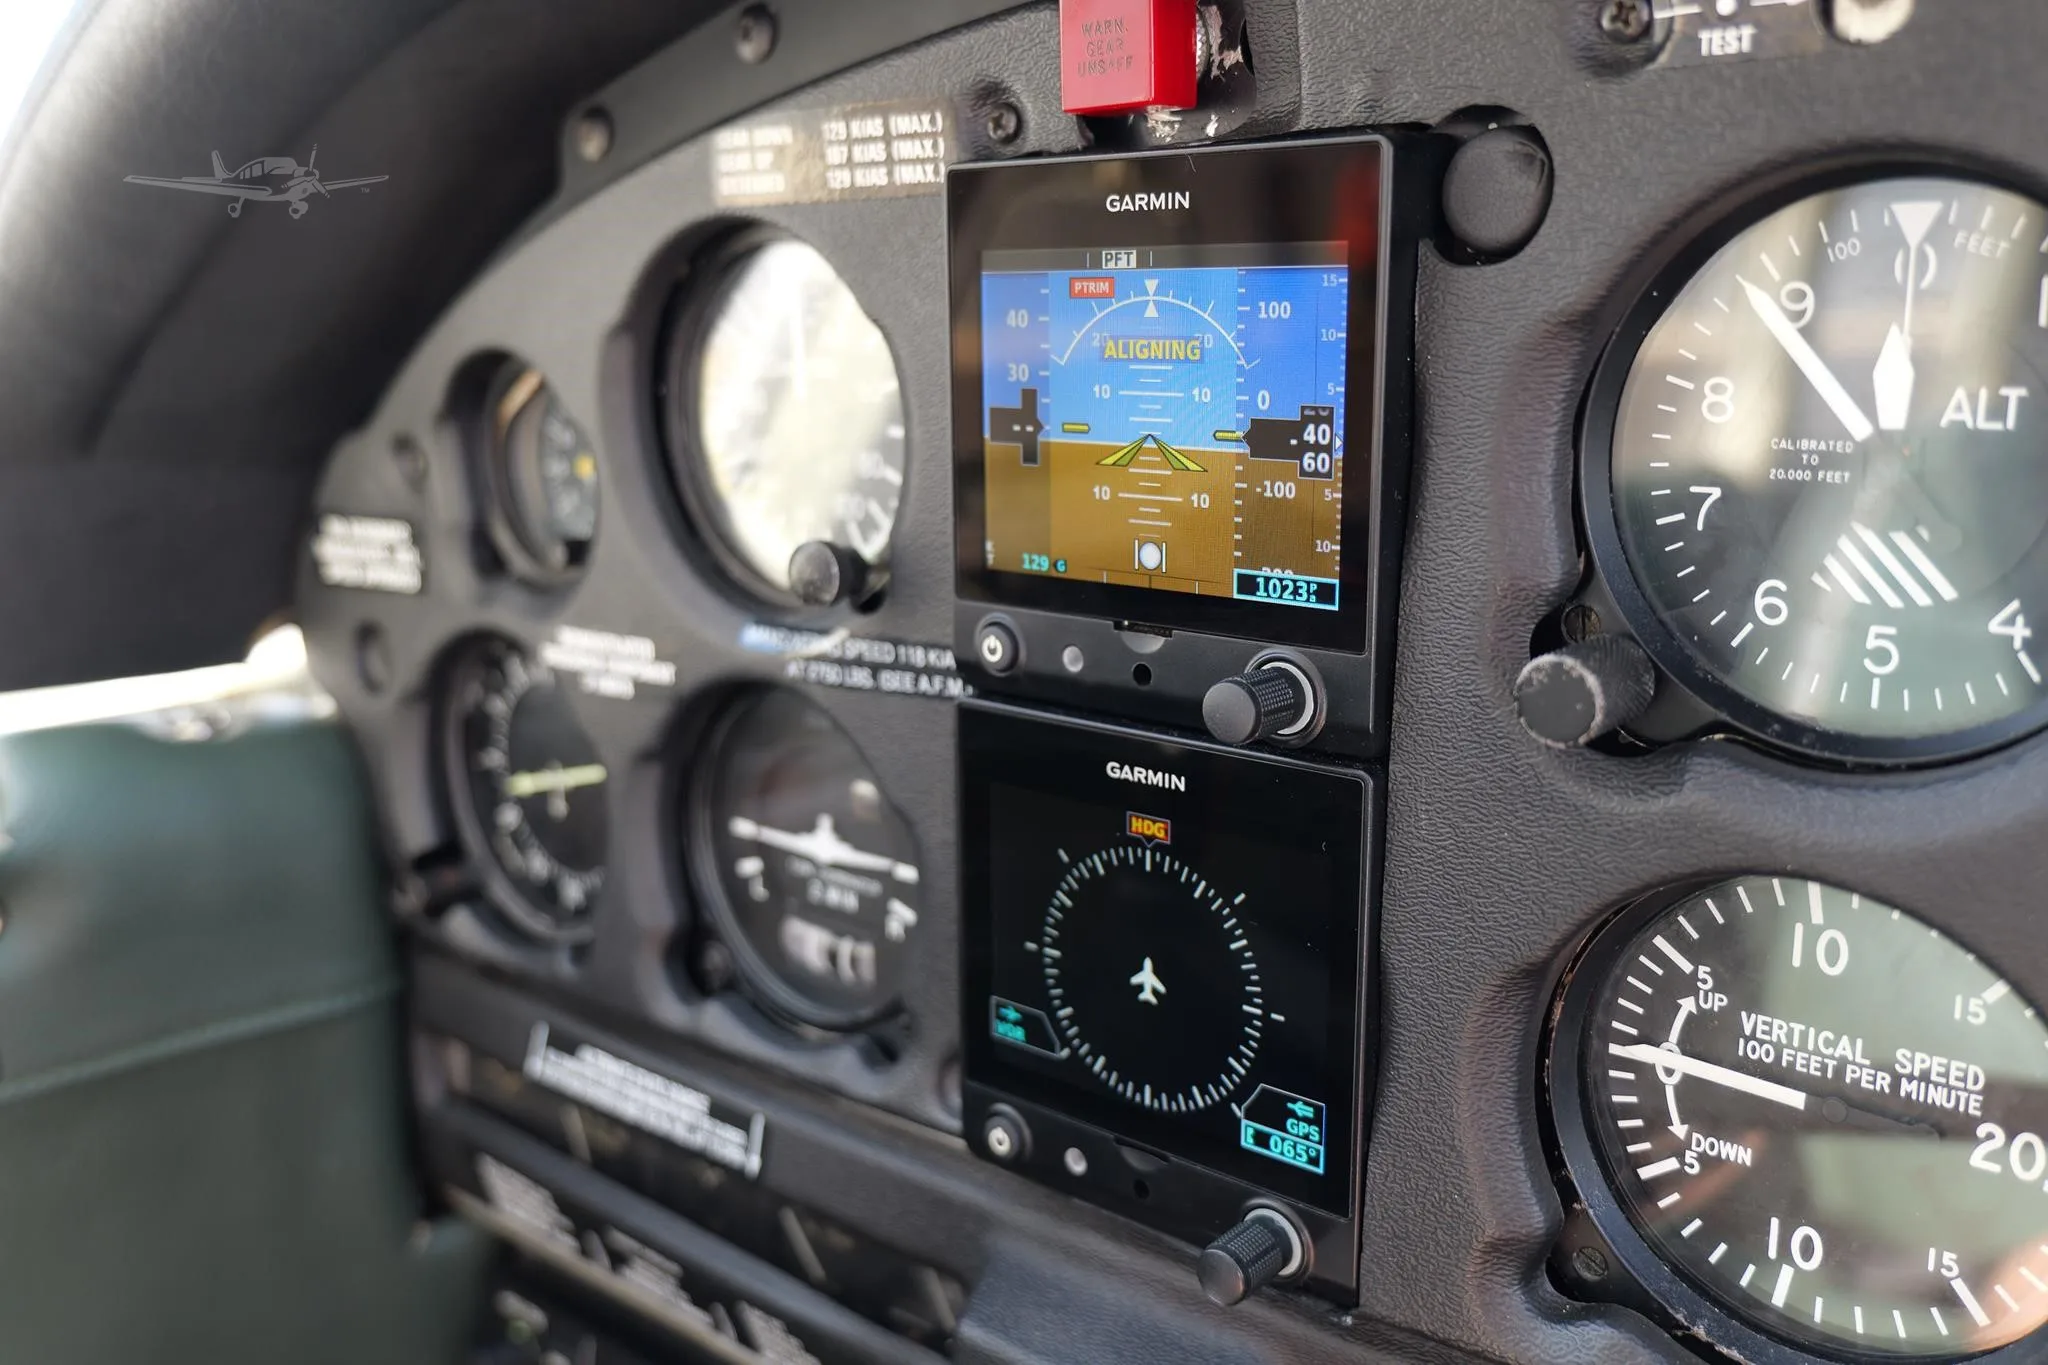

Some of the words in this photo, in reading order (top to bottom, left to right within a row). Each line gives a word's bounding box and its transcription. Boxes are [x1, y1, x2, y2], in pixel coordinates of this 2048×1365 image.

[1699, 25, 1757, 56] TEST
[1106, 191, 1190, 213] GARMIN
[1827, 239, 1861, 262] 100
[1954, 229, 2010, 258] FEET
[1104, 251, 1135, 268] PFT
[1074, 281, 1110, 295] PTRIM
[1322, 273, 1337, 287] 15
[1258, 301, 1290, 319] 100
[1780, 281, 1815, 329] 9
[1006, 309, 1028, 328] 40
[1321, 328, 1336, 342] 10
[1104, 339, 1200, 360] ALIGNING
[1007, 364, 1029, 382] 30
[1093, 384, 1111, 399] 10
[1192, 387, 1210, 402] 10
[1257, 389, 1270, 410] 0
[1701, 377, 1735, 423] 8
[1940, 386, 2028, 430] ALT
[1771, 438, 1854, 453] CALIBRATED
[1302, 452, 1330, 473] 60
[1802, 454, 1819, 465] TO
[1817, 470, 1850, 484] FEET
[1093, 486, 1111, 500] 10
[1191, 494, 1210, 508] 10
[1689, 486, 1722, 531] 7
[1315, 540, 1331, 553] 10
[1256, 577, 1308, 602] 1023
[1753, 579, 1789, 626] 6
[1988, 598, 2031, 650] 4
[927, 648, 956, 670] KIA
[1863, 625, 1900, 674] 5
[1106, 761, 1186, 792] GARMIN
[1130, 817, 1167, 841] HDG
[1792, 922, 1849, 976] 10
[1697, 965, 1713, 990] 5
[1698, 991, 1728, 1013] UP
[1954, 995, 1987, 1025] 15
[1741, 1011, 1871, 1066] VERTICAL
[1895, 1048, 1985, 1091] SPEED
[1738, 1037, 1776, 1064] 100
[1781, 1048, 1837, 1079] FEET
[1845, 1063, 1891, 1093] PER
[1899, 1076, 1984, 1117] MINUTE
[1286, 1118, 1320, 1142] GPS
[1269, 1134, 1316, 1163] 065°
[1691, 1132, 1752, 1167] DOWN
[1969, 1122, 2046, 1181] 20
[1684, 1151, 1700, 1175] 5
[1768, 1217, 1823, 1271] 10
[1928, 1247, 1961, 1278] 15
